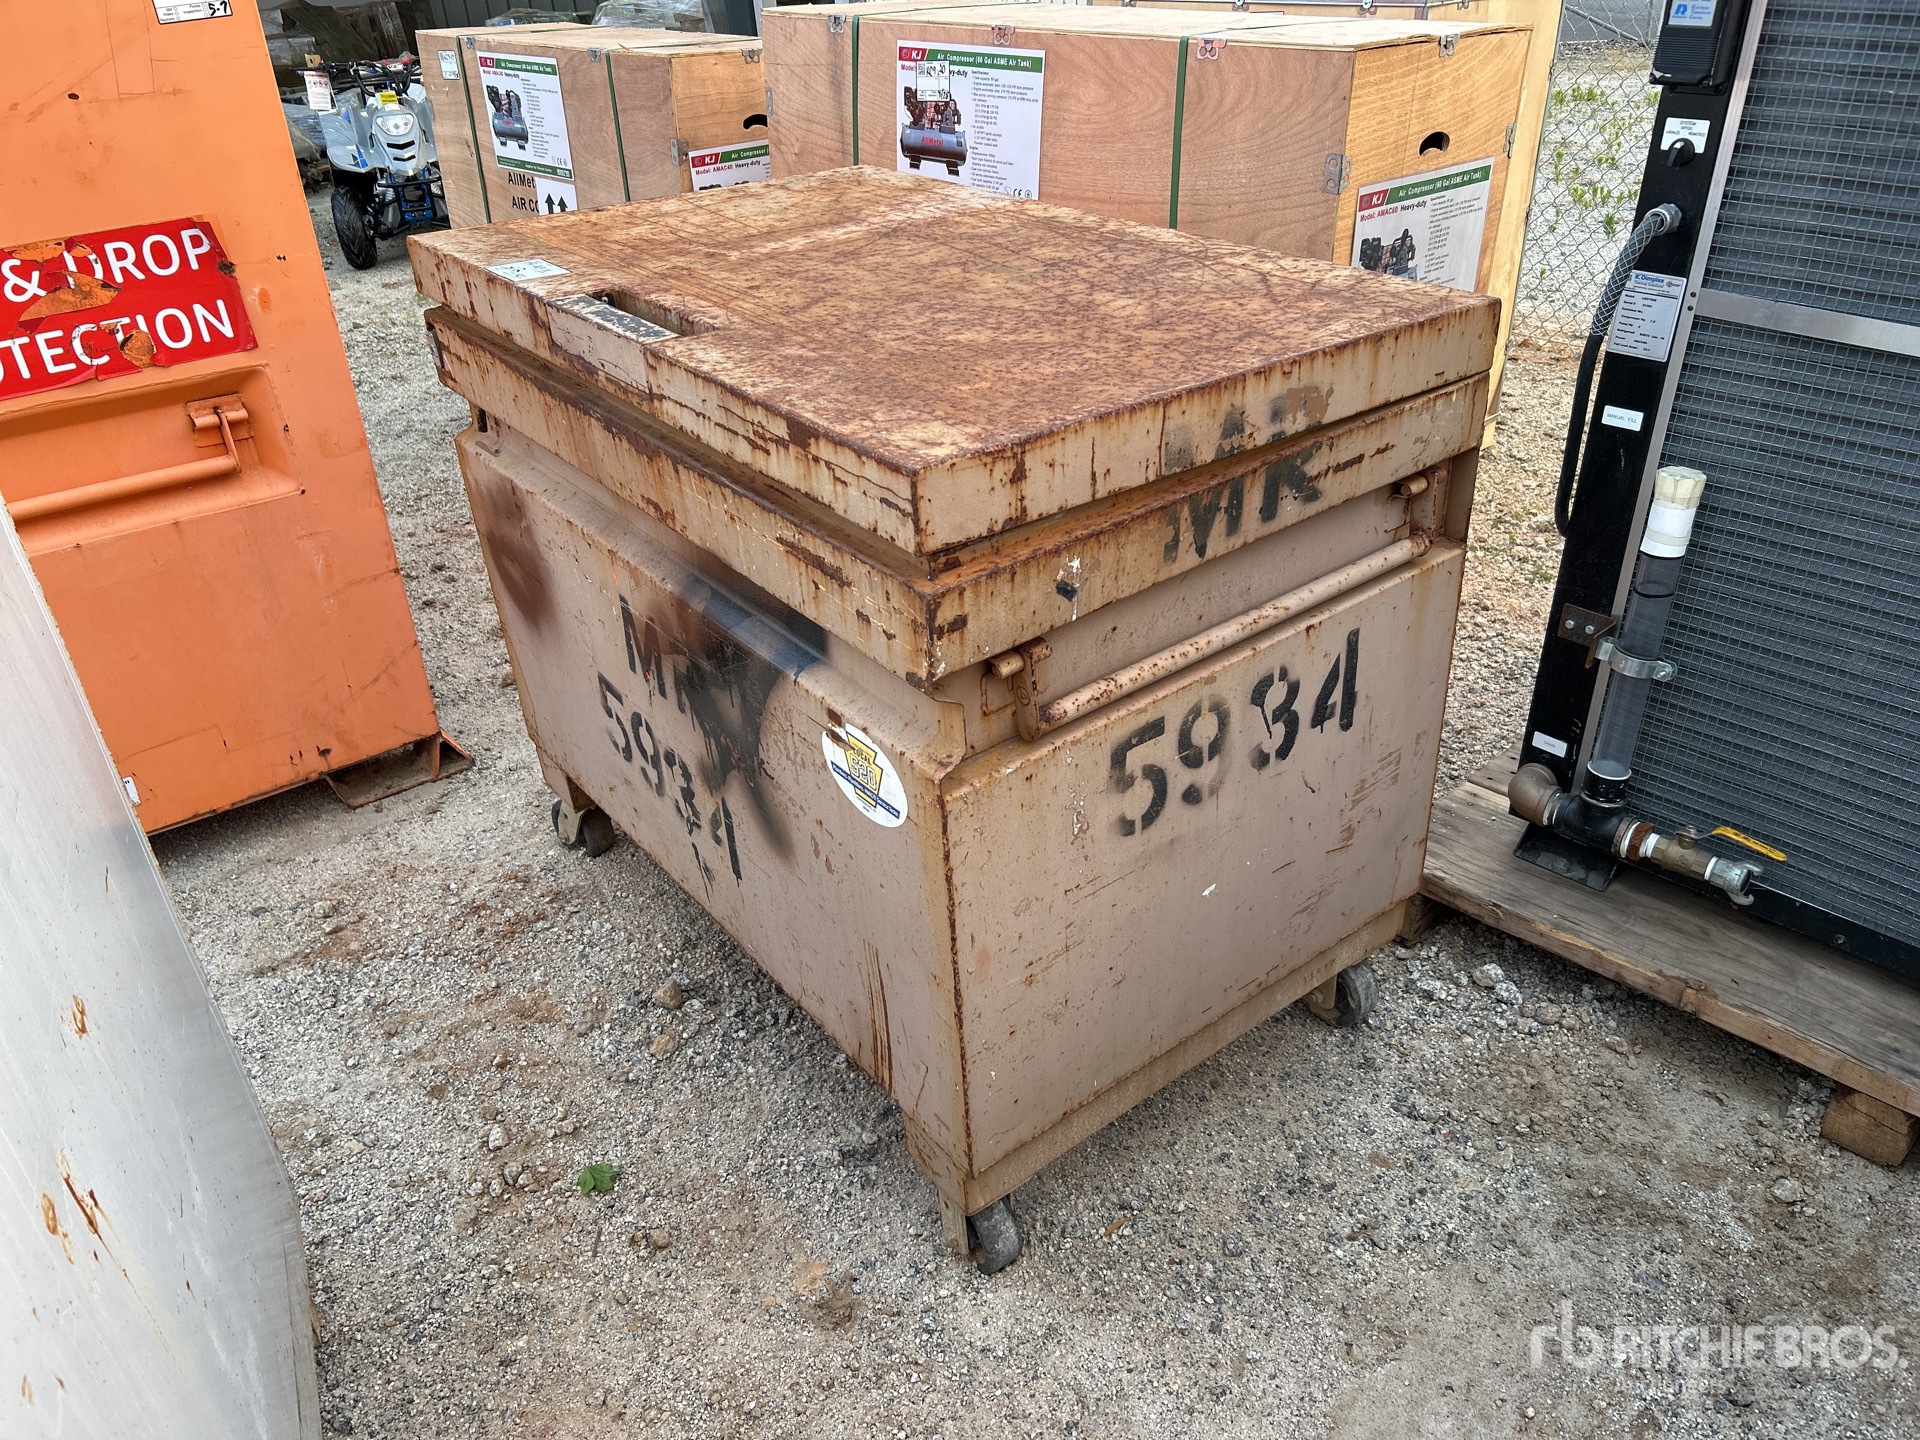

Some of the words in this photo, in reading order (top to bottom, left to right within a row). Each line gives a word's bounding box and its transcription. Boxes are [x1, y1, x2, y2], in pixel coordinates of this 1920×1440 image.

[911, 50, 922, 60] KJ
[946, 54, 974, 64] Compressor
[993, 57, 1008, 66] ASME
[740, 149, 766, 157] Compressor
[704, 155, 716, 164] KJ
[735, 160, 761, 168] Heavy-duty
[1398, 189, 1406, 198] Air
[1407, 184, 1435, 196] Compressor
[512, 196, 527, 211] AIR
[1372, 193, 1384, 205] KJ
[1360, 212, 1376, 222] Model:
[1400, 199, 1428, 212] Heavy-duty
[0, 258, 47, 303] &
[63, 228, 211, 289] DROP
[0, 299, 235, 385] TECTION
